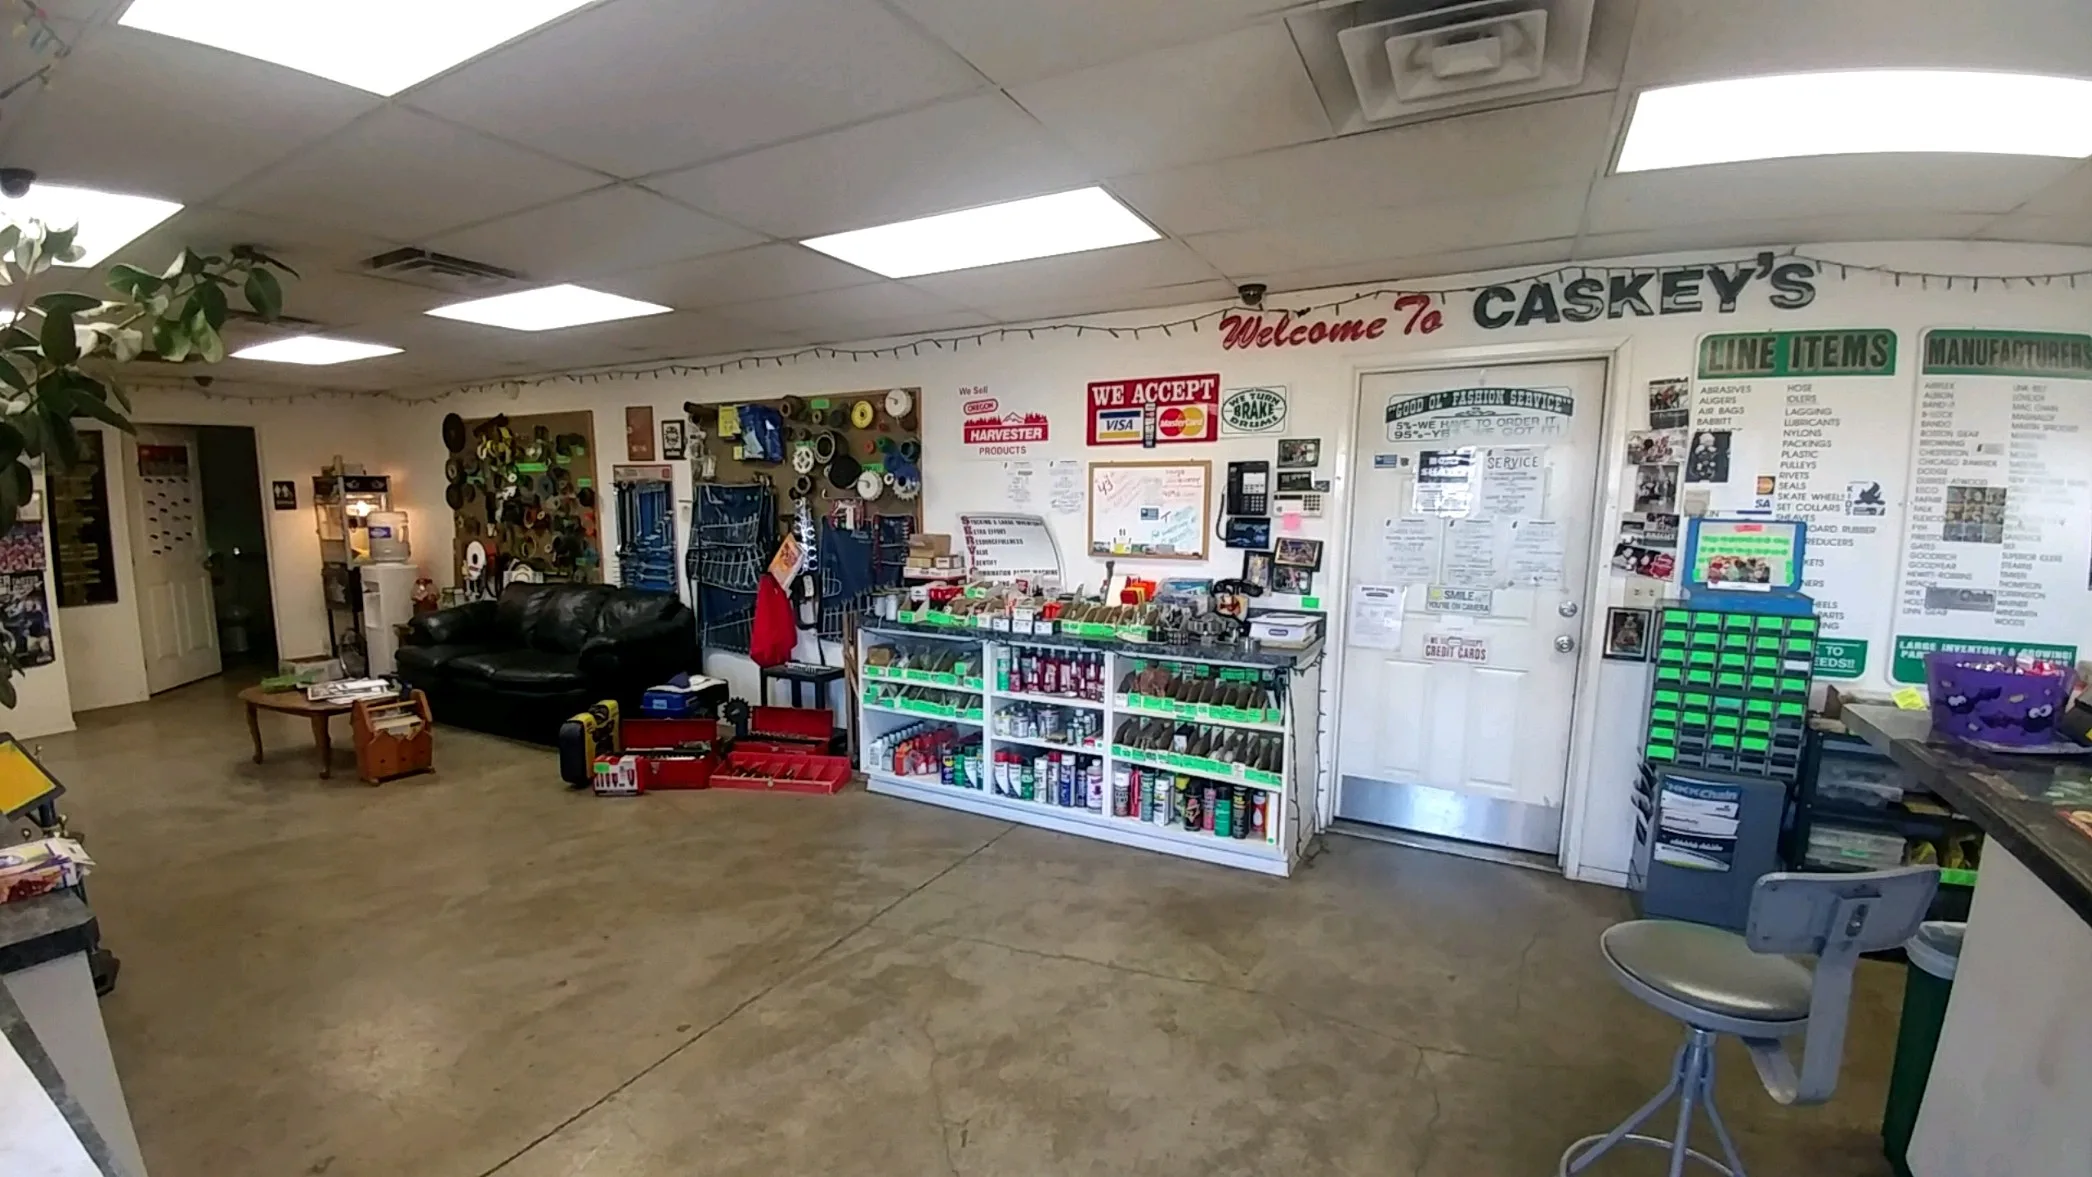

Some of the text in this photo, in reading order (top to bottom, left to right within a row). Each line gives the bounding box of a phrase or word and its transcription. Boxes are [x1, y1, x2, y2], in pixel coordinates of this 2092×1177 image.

[1473, 251, 1816, 329] CASKEY'S
[1219, 294, 1443, 350] Welcome To
[1708, 333, 1889, 372] LINE ITEMS
[973, 386, 988, 394] Sell
[1092, 378, 1214, 406] WE ACCEPT
[1700, 385, 1752, 394] ABRASIVES
[1787, 384, 1812, 392] HOSE
[1230, 392, 1280, 407] WE TURN
[1452, 390, 1505, 406] FASHION
[1699, 396, 1737, 404] AUGERS
[1786, 395, 1817, 403] IDLERS
[967, 402, 994, 412] OREGON
[1234, 402, 1275, 420] BRAKE
[1718, 406, 1745, 415] BAGS
[1785, 408, 1832, 416] LAGGING
[1106, 419, 1133, 431] VISA
[1160, 418, 1203, 428] MasterCard
[1477, 418, 1492, 428] TO
[1497, 417, 1540, 428] ORDER
[1544, 416, 1556, 426] IT
[1696, 417, 1732, 426] BABBITT
[1784, 419, 1840, 427] LUBRICANTS
[970, 428, 1042, 442] HARVESTER
[1502, 426, 1535, 436] GOT
[1783, 429, 1822, 438] NYLONS
[1782, 440, 1832, 448] PACKINGS
[979, 446, 1027, 455] PRODUCTS
[1781, 450, 1818, 458] PLASTIC
[1487, 457, 1538, 470] SERVICE
[1780, 461, 1816, 469] PULLEYS
[1779, 472, 1809, 480] RIVETS
[1778, 482, 1806, 490] SEALS
[1777, 503, 1840, 512] SET COLLARS
[1842, 526, 1876, 534] RUBBER
[1807, 538, 1854, 546] REDUCERS
[1444, 590, 1475, 600] SMILE
[1425, 645, 1487, 660] CREDIT CARDS
[1826, 645, 1844, 656] TO
[1899, 641, 1937, 650] LARGE
[1942, 644, 2004, 655] INVENTORY
[1815, 656, 1855, 669] EEDS!!
